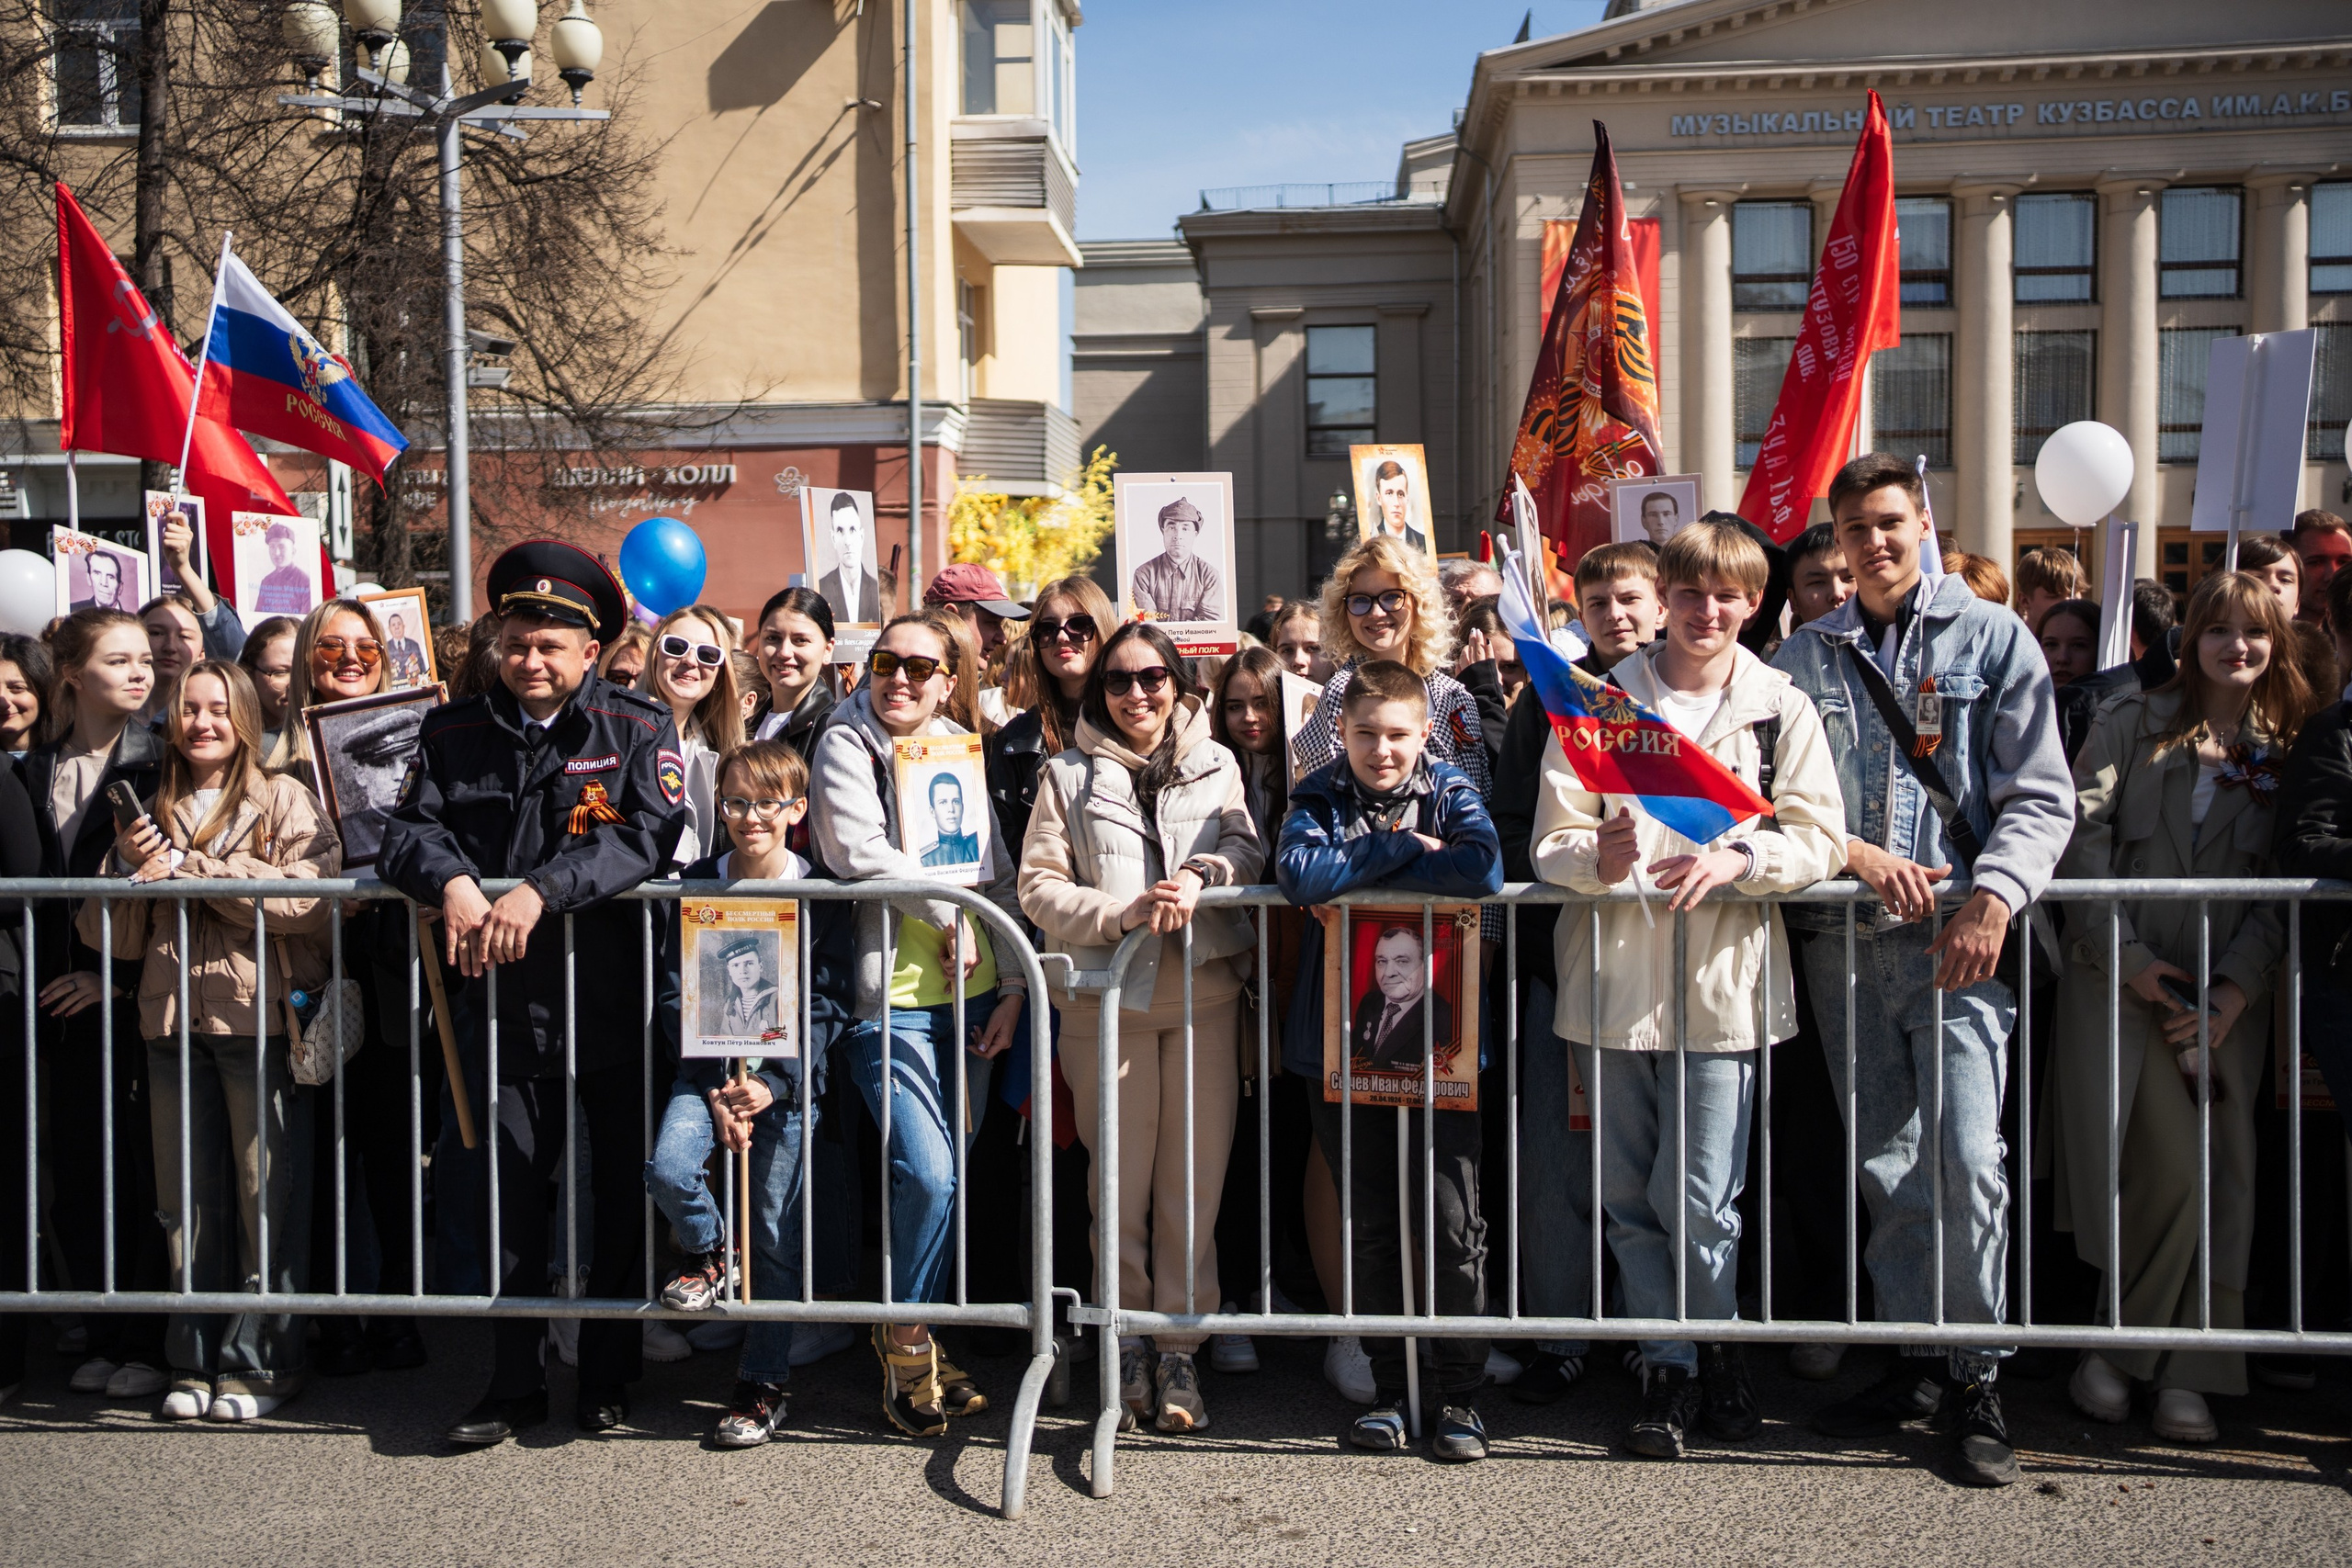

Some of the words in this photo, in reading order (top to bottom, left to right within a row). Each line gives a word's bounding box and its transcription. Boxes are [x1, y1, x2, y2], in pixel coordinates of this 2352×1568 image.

[1925, 105, 2024, 129] ТЕАТР
[2037, 97, 2201, 124] КУЗБАССА
[1827, 234, 1860, 270] 150
[285, 392, 347, 442] РОССИЯ
[1198, 646, 1220, 654] ПОЛК
[1557, 725, 1683, 758] РОССИЯ
[568, 756, 616, 771] ПОЛИЦИЯ
[1371, 1075, 1399, 1093] Иван
[1401, 1077, 1470, 1098] Федрович
